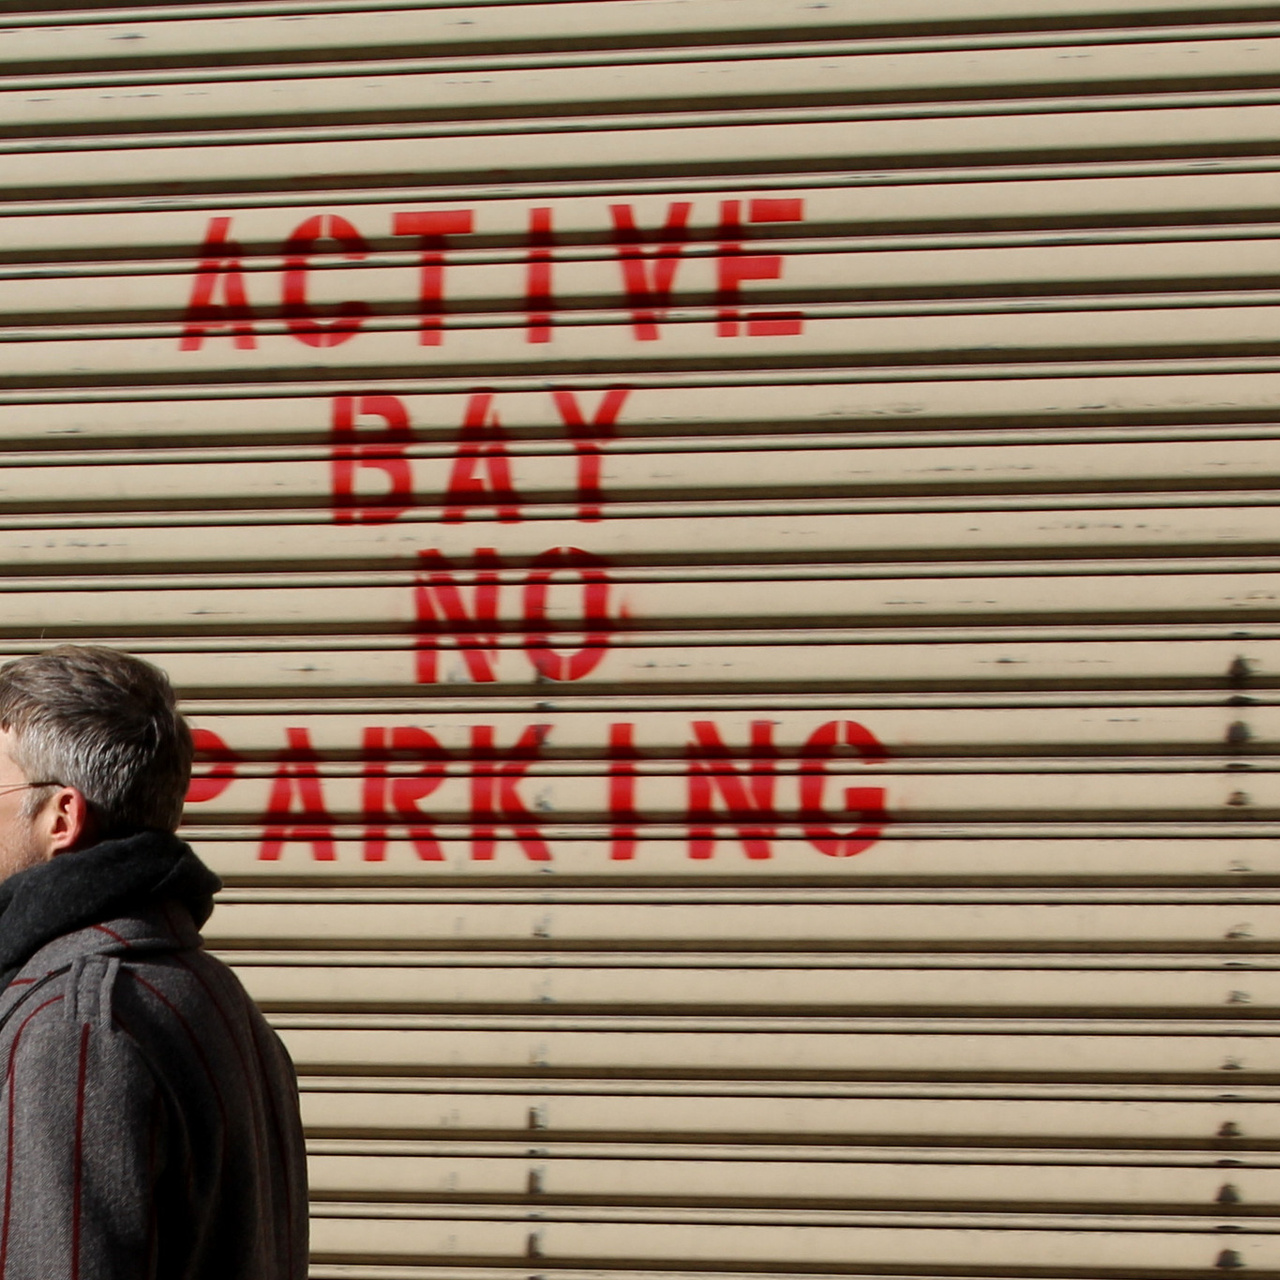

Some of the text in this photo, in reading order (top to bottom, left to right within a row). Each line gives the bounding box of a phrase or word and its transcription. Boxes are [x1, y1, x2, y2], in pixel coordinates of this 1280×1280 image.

[179, 199, 803, 351] ACTIVE
[330, 387, 631, 524] BAY
[412, 547, 611, 683] NO
